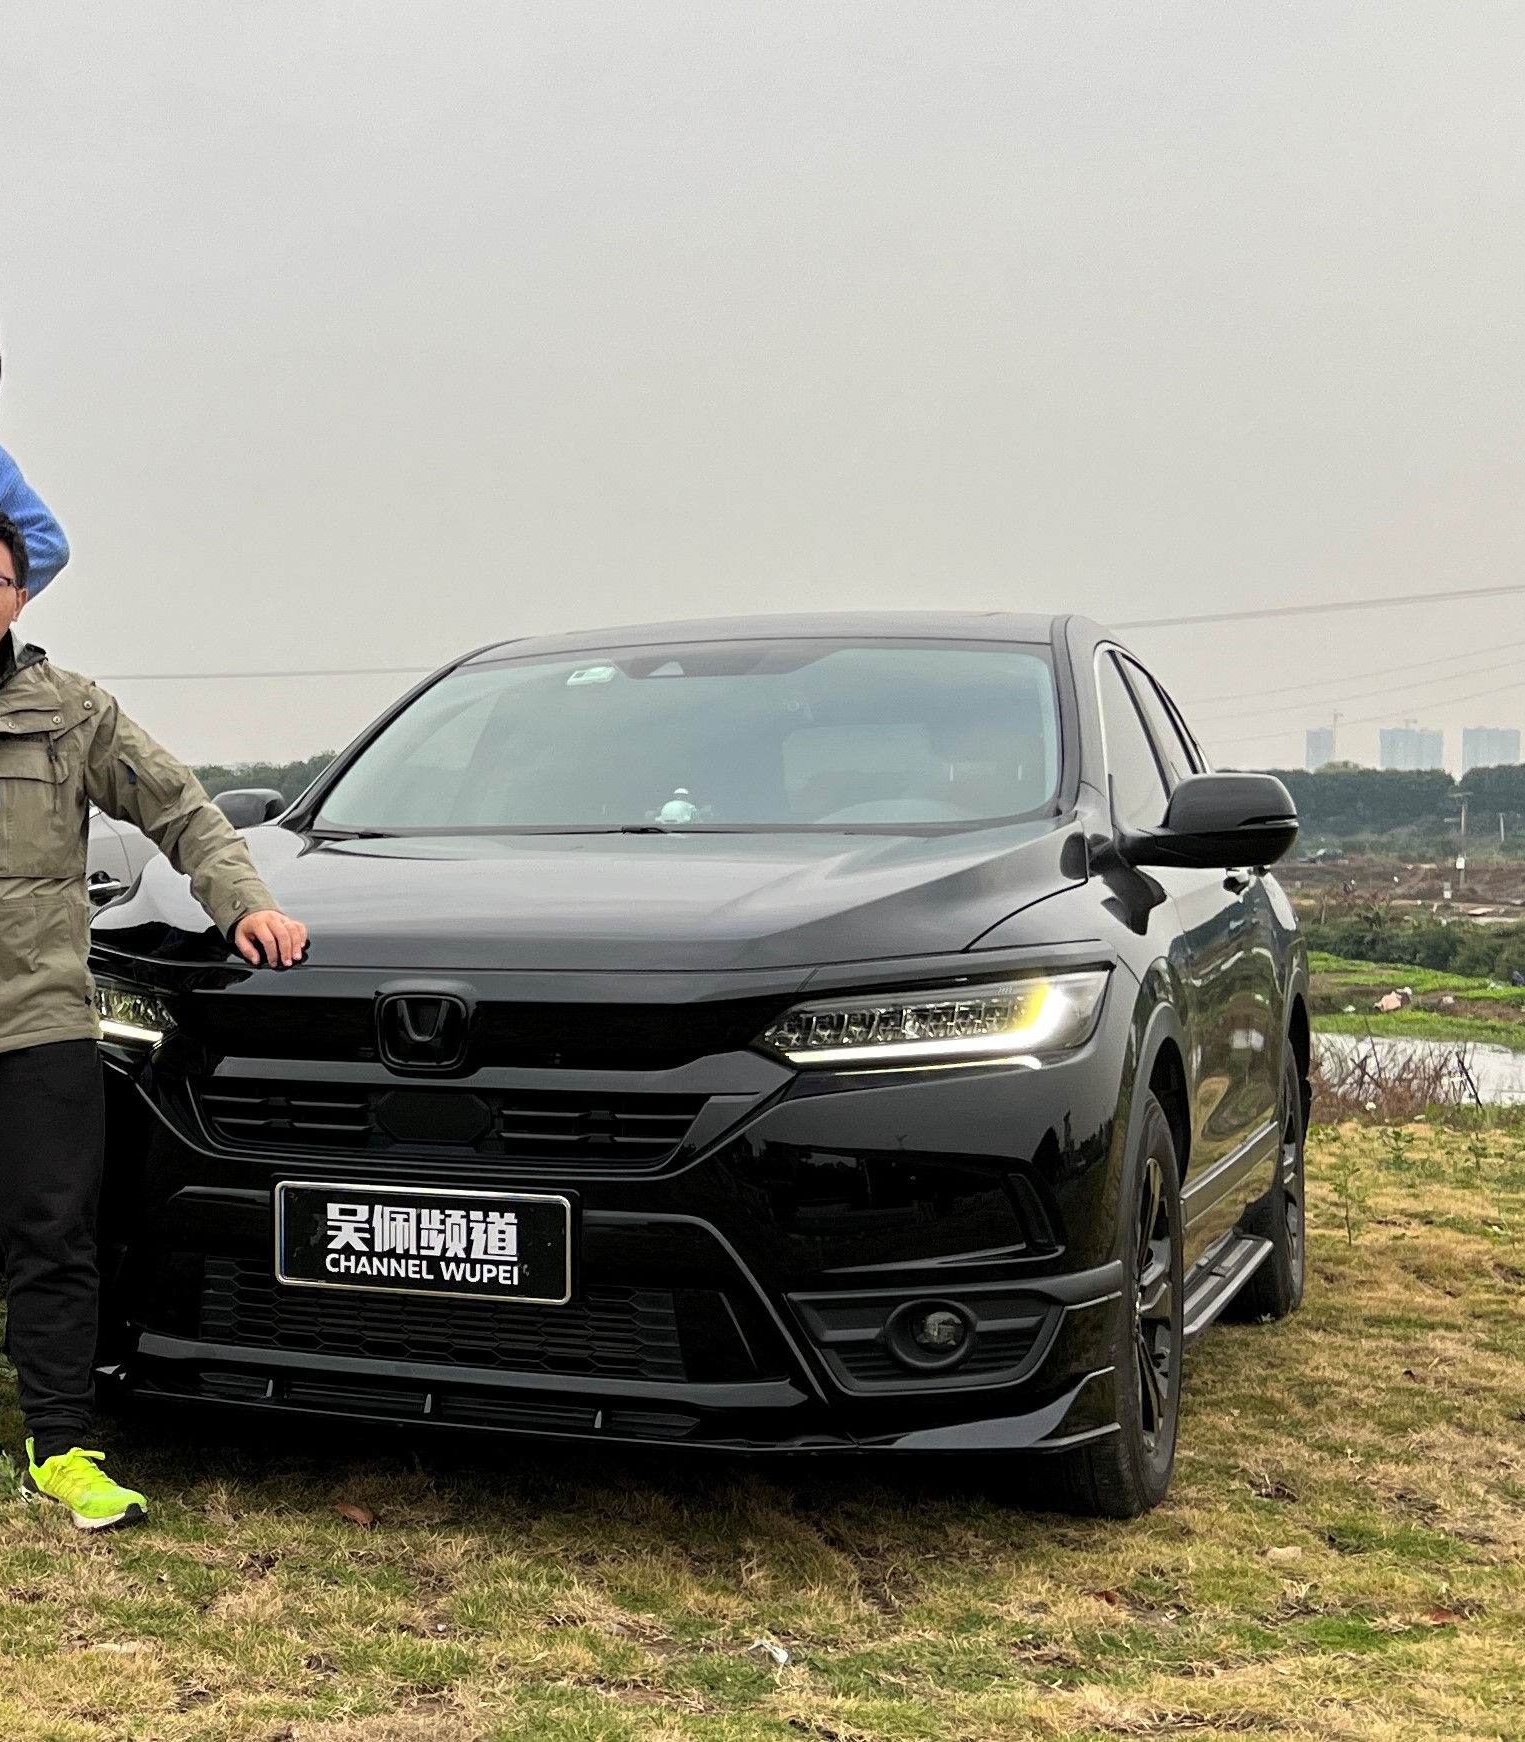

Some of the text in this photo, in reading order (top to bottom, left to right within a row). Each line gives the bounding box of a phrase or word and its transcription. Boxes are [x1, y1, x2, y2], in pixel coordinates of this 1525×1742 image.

[326, 1202, 519, 1262] 吴佩频道
[325, 1253, 519, 1286] CHANNEL WUPEI
